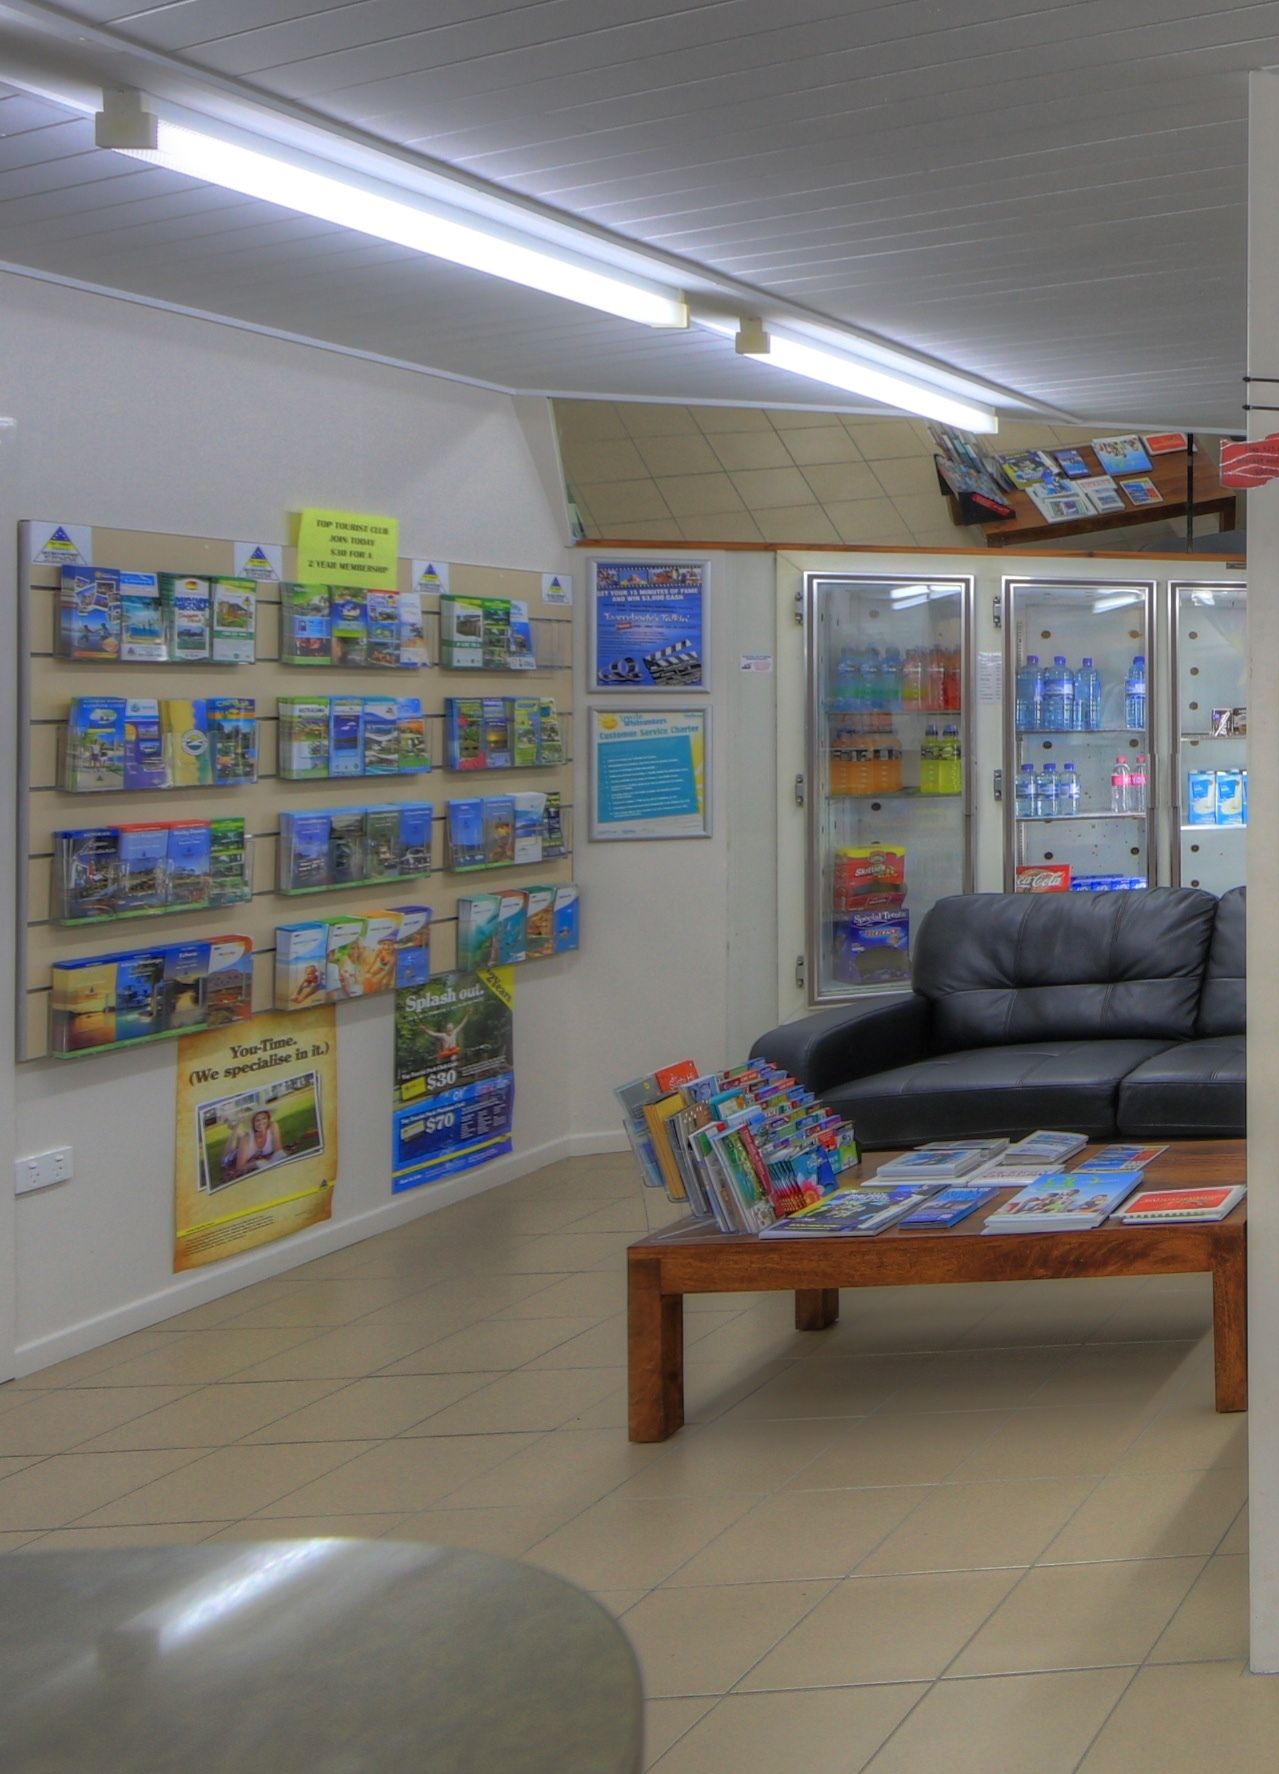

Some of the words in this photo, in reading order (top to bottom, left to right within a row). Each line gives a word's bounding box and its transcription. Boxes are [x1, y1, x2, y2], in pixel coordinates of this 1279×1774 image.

[335, 521, 368, 533] TOURIST
[369, 526, 389, 535] CLUB
[329, 535, 348, 543] JOIN
[350, 536, 375, 546] TODAY
[349, 549, 366, 558] FOR
[316, 560, 337, 570] YEAR
[338, 562, 389, 574] MEMBERSHIP
[599, 730, 637, 740] Customer
[640, 727, 668, 736] Service
[670, 725, 699, 735] Charter
[404, 988, 457, 1014] Splash
[458, 982, 485, 1000] out.
[229, 1035, 298, 1059] You-Time.
[189, 1068, 219, 1086] (We
[223, 1052, 293, 1079] specialise
[295, 1047, 308, 1061] in
[311, 1042, 330, 1057] it.)
[427, 1068, 458, 1091] $30
[452, 1090, 463, 1101] or
[425, 1113, 455, 1134] $70
